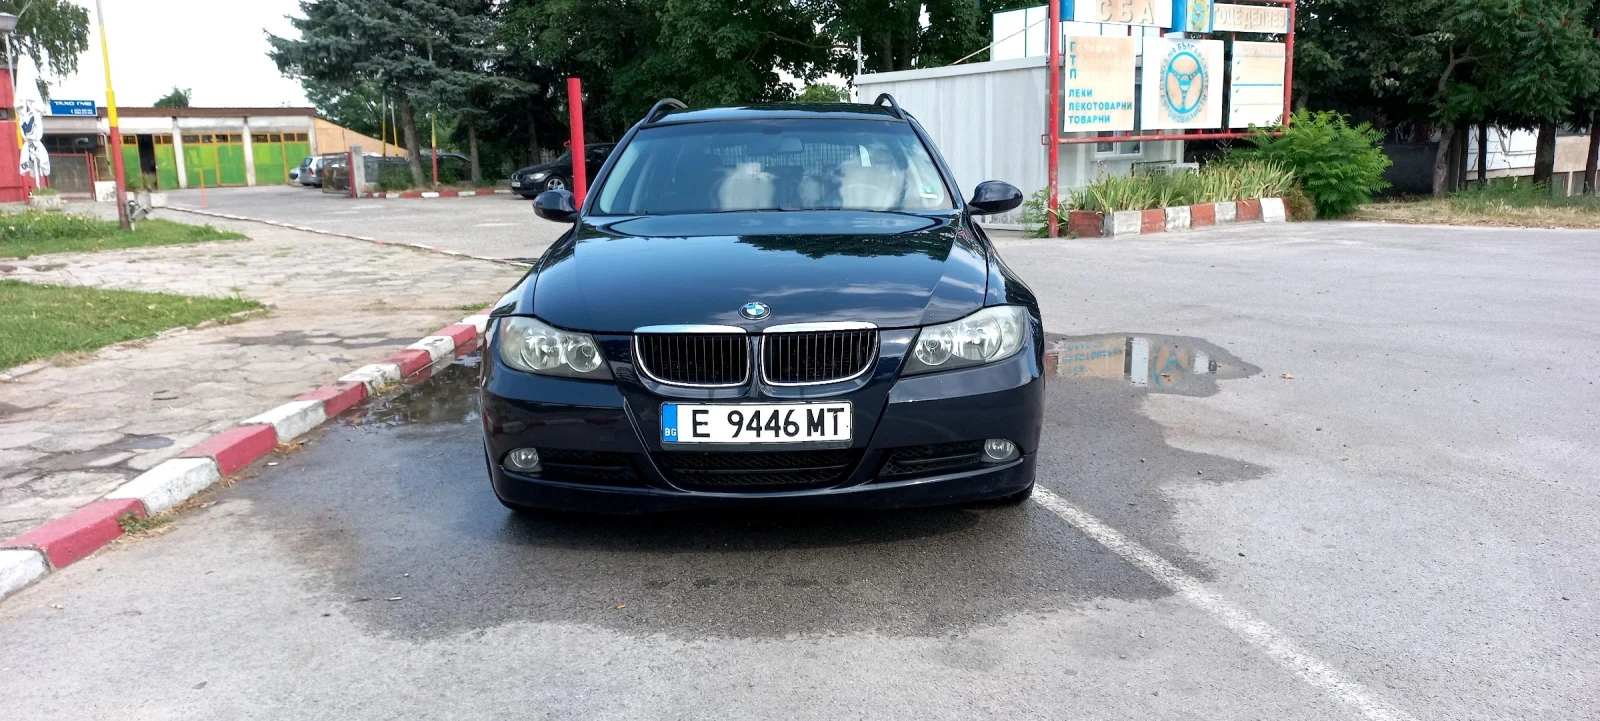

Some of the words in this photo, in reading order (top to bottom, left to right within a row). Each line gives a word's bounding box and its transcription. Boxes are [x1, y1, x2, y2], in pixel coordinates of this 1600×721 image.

[1100, 0, 1155, 24] СБА
[1068, 89, 1093, 98] ЛЕКИ
[1068, 102, 1132, 111] ЛЕКОТОВАРНИ
[1068, 115, 1110, 124] ТОВАРНИ
[692, 409, 711, 438] E
[727, 408, 800, 438] 9446
[806, 407, 845, 437] MT
[664, 427, 677, 436] BG
